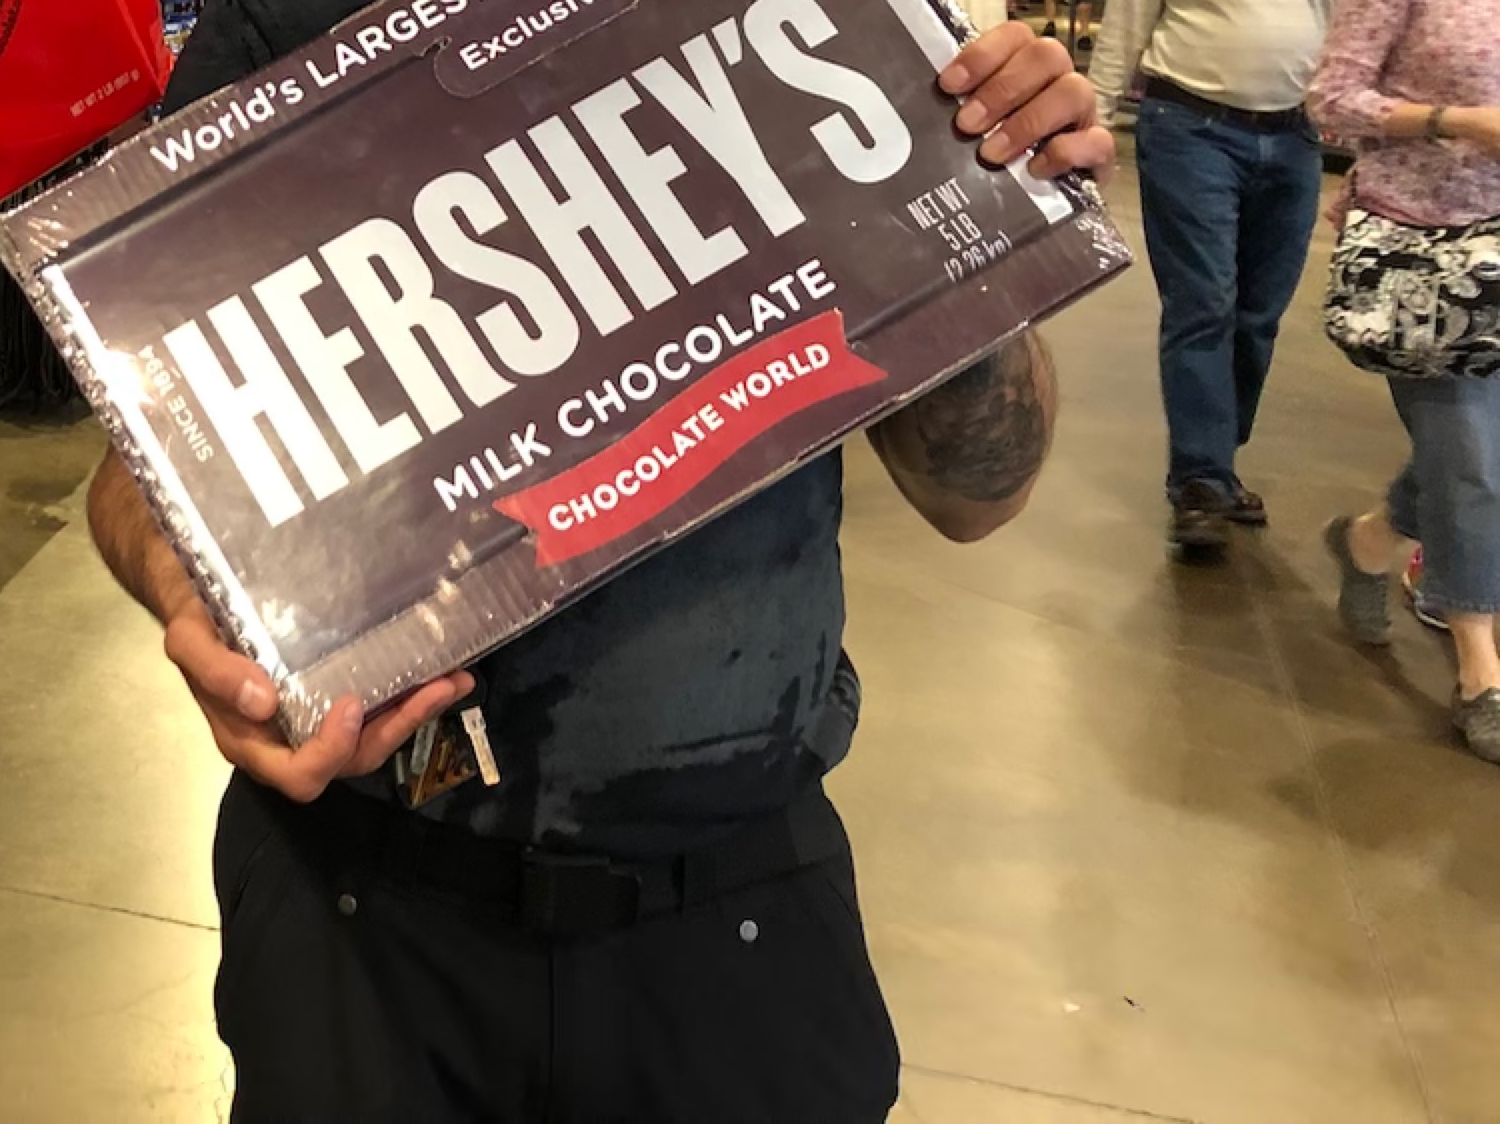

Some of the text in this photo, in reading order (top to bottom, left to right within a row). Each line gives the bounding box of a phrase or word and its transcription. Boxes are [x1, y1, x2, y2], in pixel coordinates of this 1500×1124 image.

[150, 77, 304, 172] World's
[905, 177, 971, 231] NET WT
[938, 211, 983, 251] 5 LB
[433, 259, 837, 512] MILK CHOCOLATE
[167, 394, 215, 463] SINCE
[548, 343, 831, 531] CHOCOLATE WORLD
